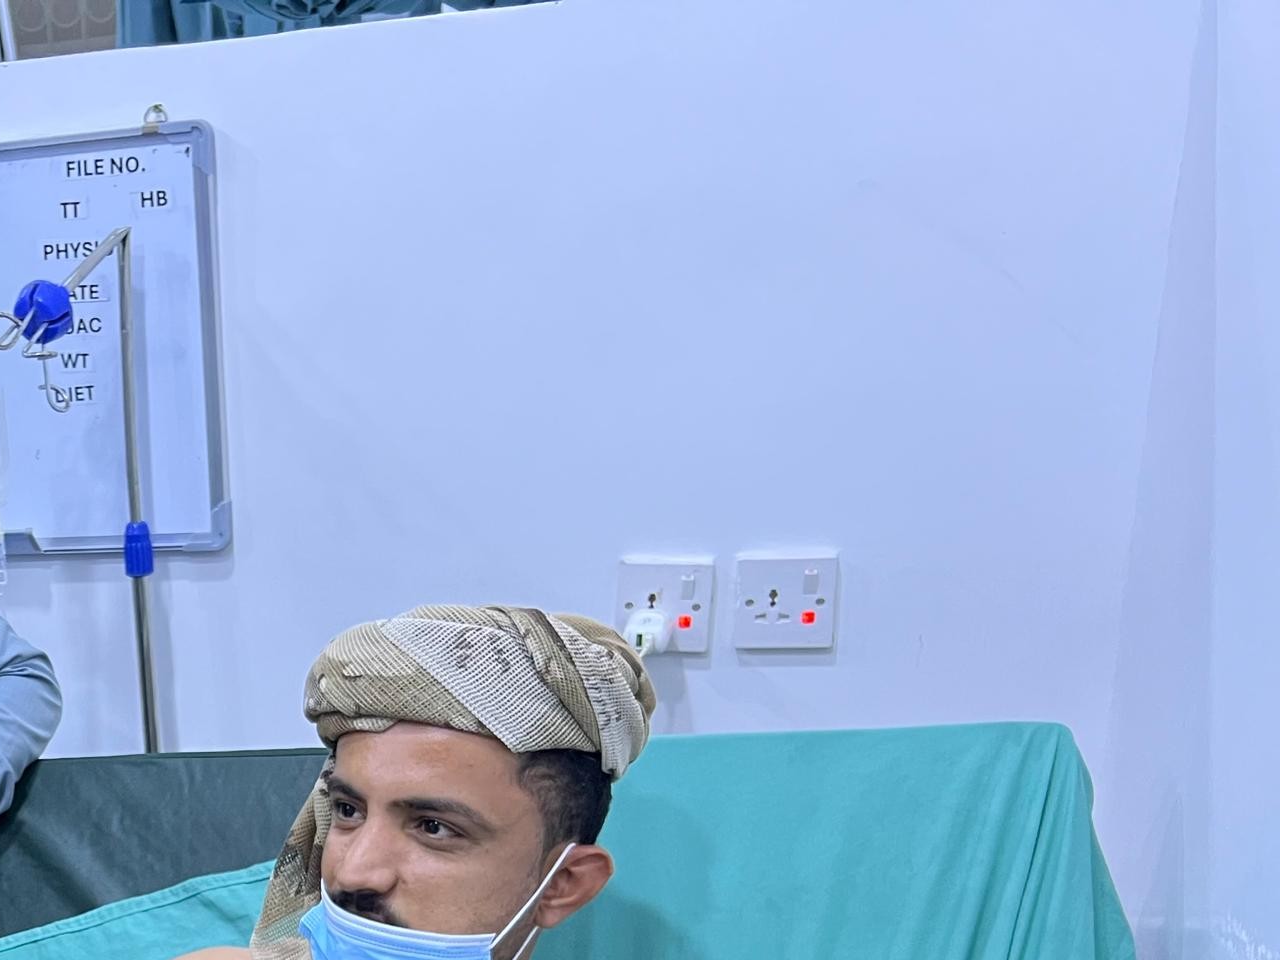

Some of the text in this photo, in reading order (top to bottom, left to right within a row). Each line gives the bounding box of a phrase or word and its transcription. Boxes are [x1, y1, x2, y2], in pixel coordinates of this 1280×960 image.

[66, 156, 146, 178] FILE NO.
[140, 190, 168, 208] HB
[60, 201, 81, 219] TT
[60, 353, 89, 369] WT
